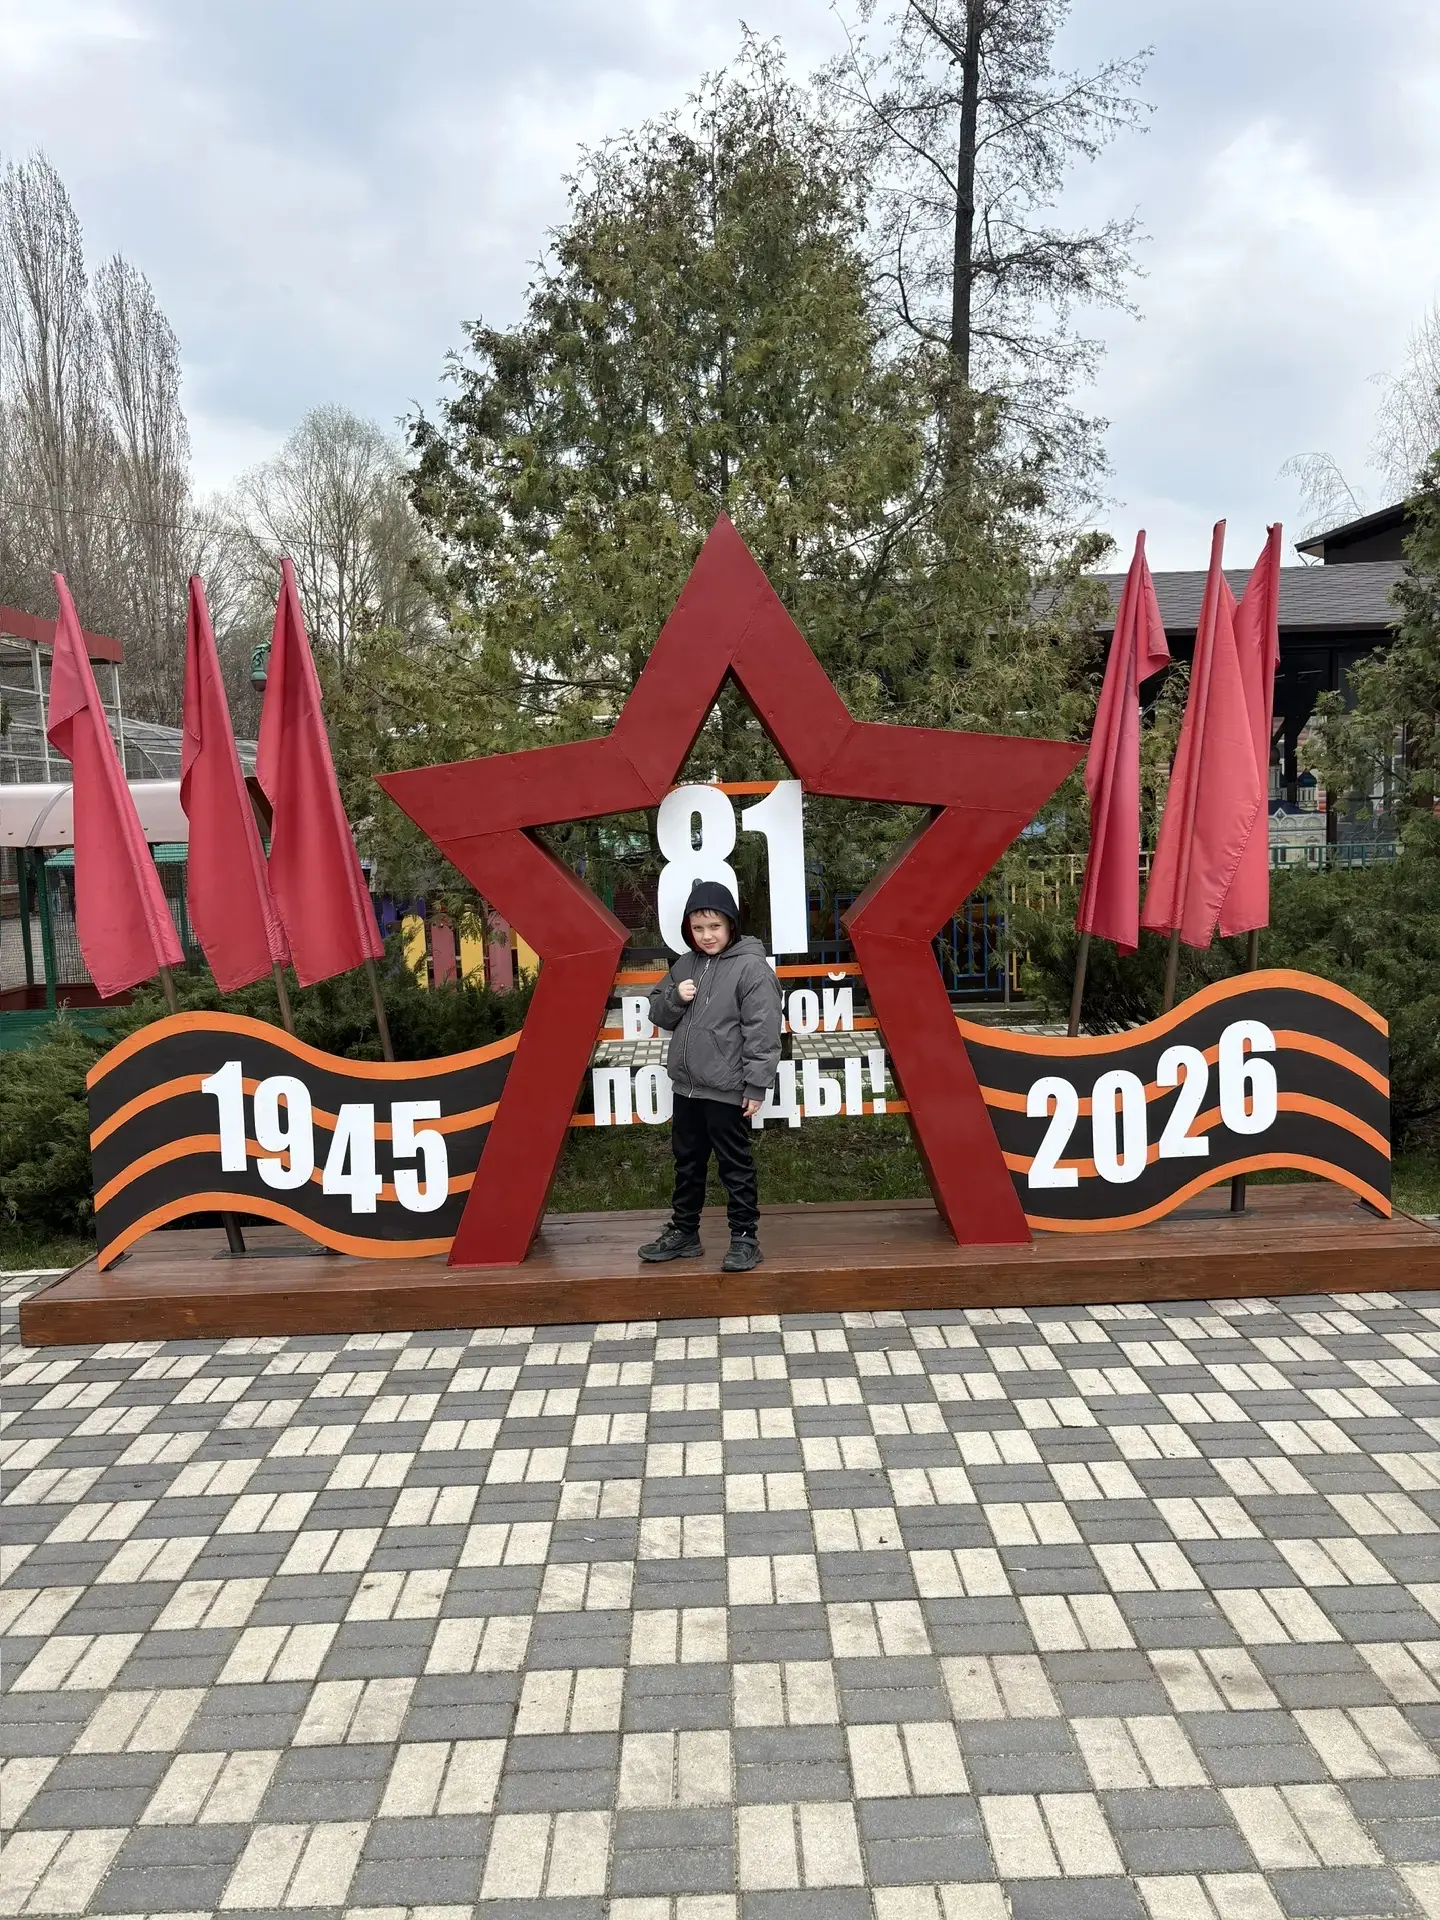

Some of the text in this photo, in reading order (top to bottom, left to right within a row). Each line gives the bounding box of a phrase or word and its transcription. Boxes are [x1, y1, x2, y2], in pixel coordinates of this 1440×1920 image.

[657, 780, 808, 955] 81
[201, 1061, 449, 1213] 1945
[592, 1049, 886, 1129] ПОДЫ!
[1026, 1020, 1277, 1188] 2026
